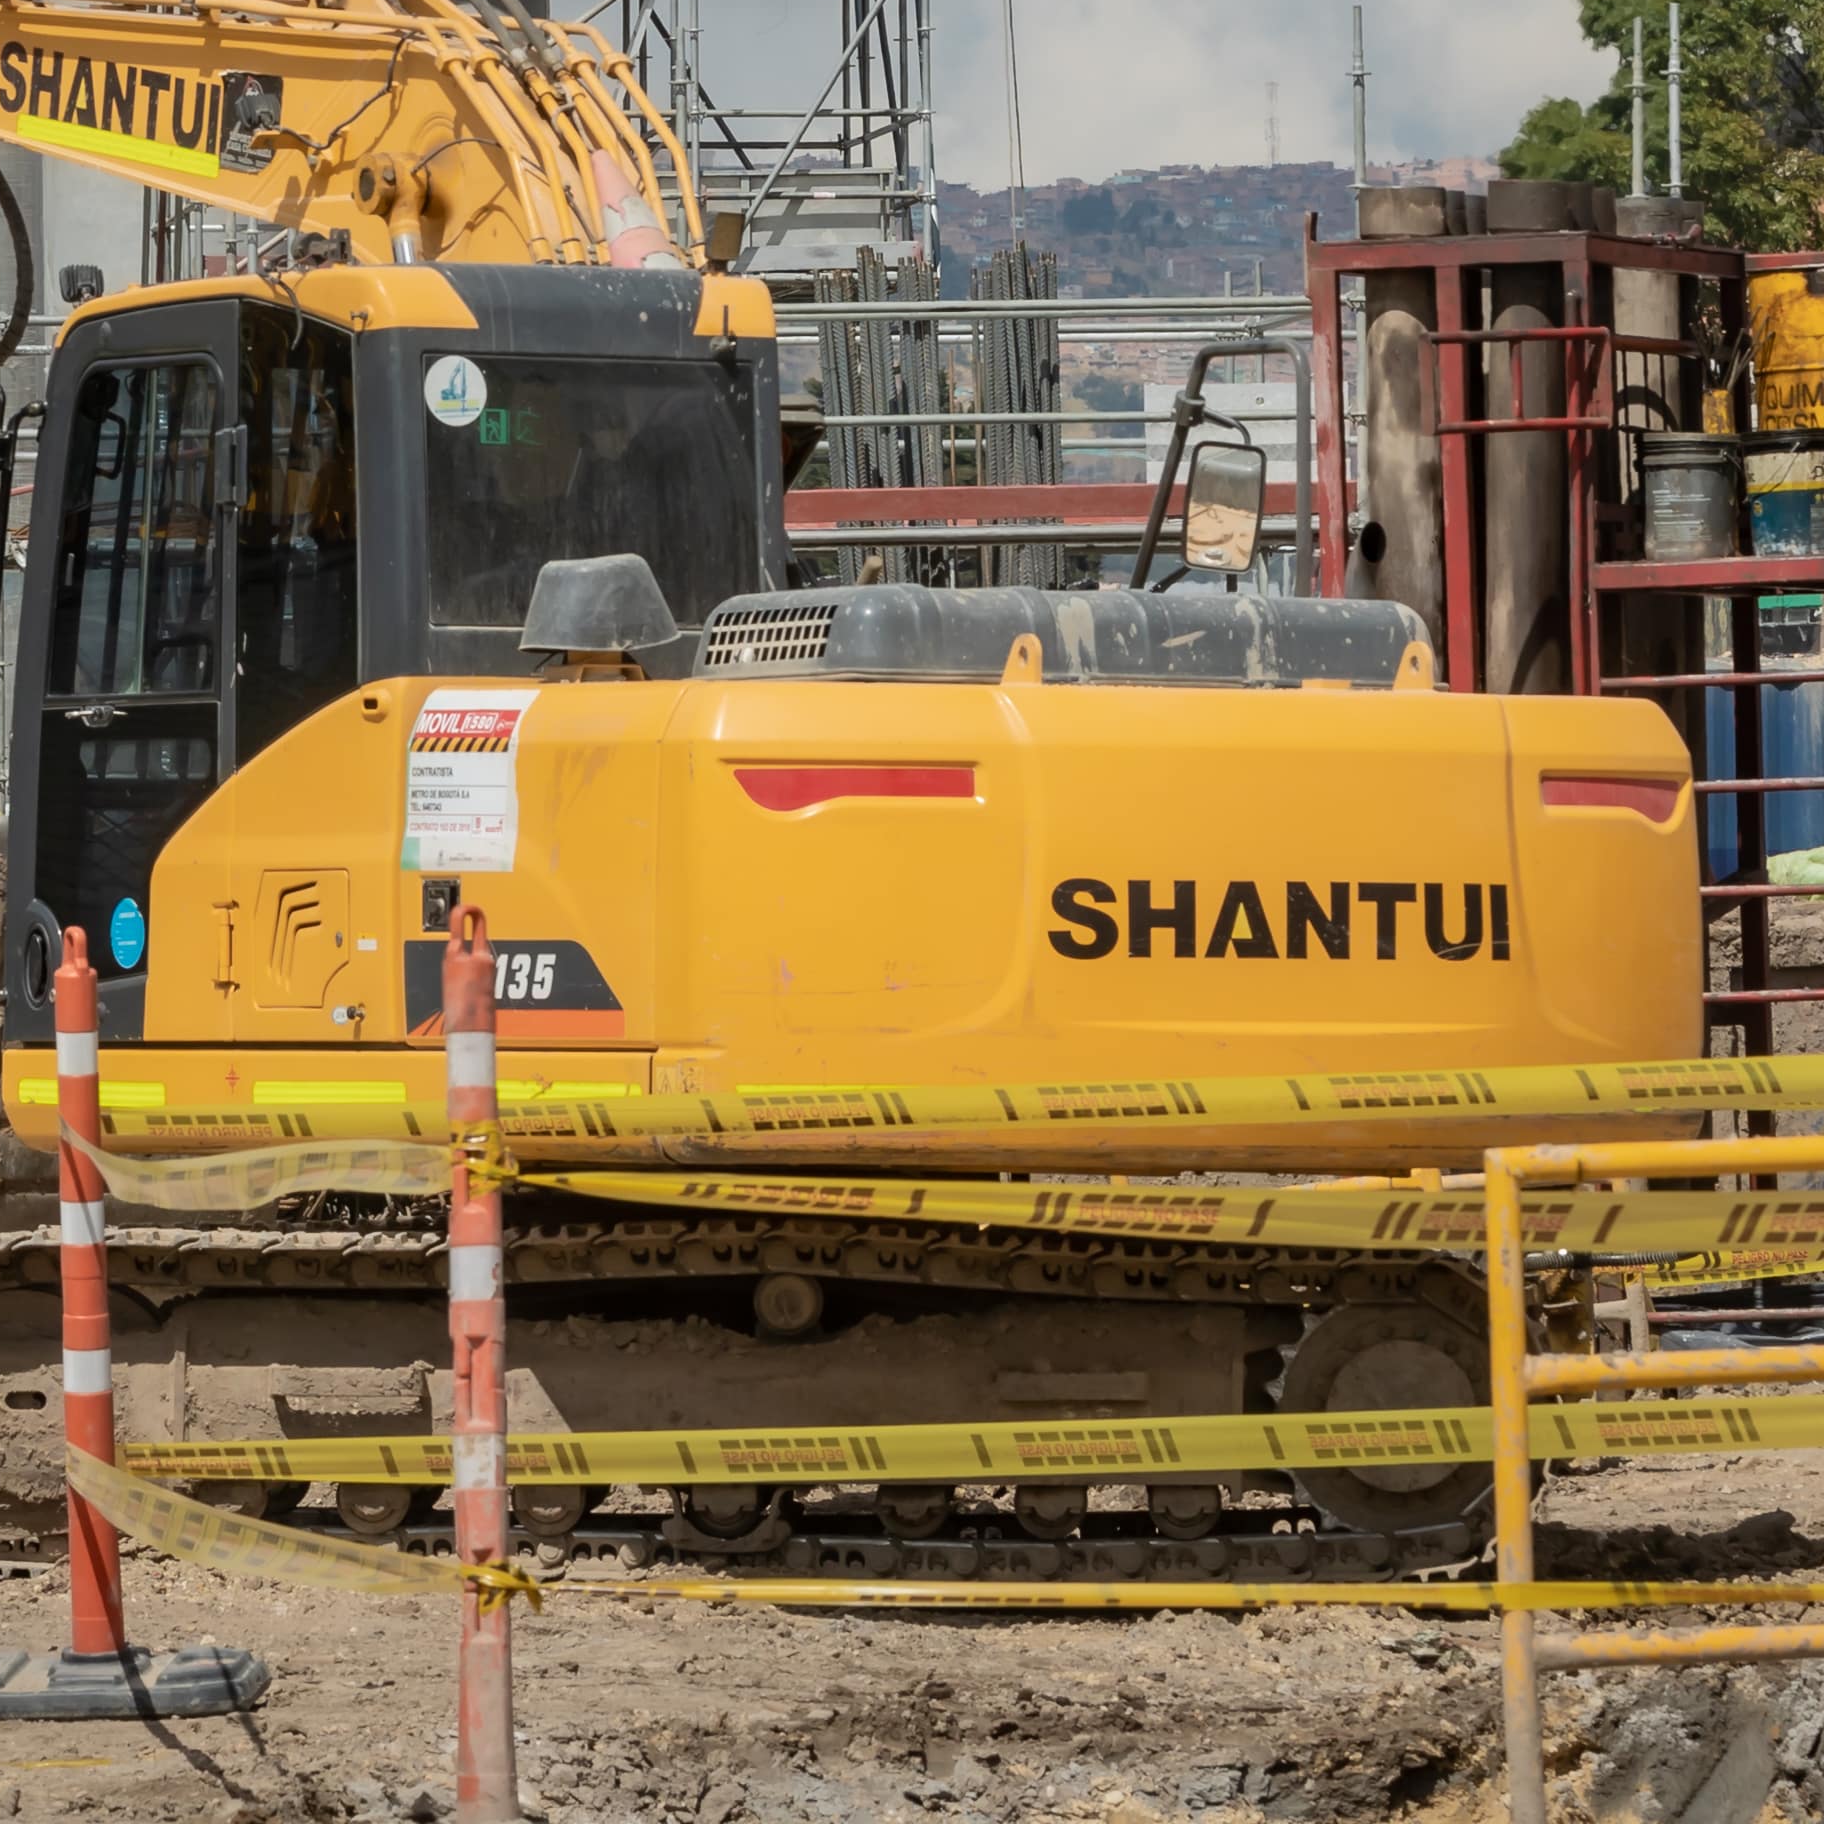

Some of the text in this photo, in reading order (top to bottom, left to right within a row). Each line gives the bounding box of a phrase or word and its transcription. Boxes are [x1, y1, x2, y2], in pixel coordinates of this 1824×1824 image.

[416, 712, 462, 734] MOVIL
[411, 766, 454, 777] CONTRATISTA
[1047, 877, 1511, 961] SHANTUI
